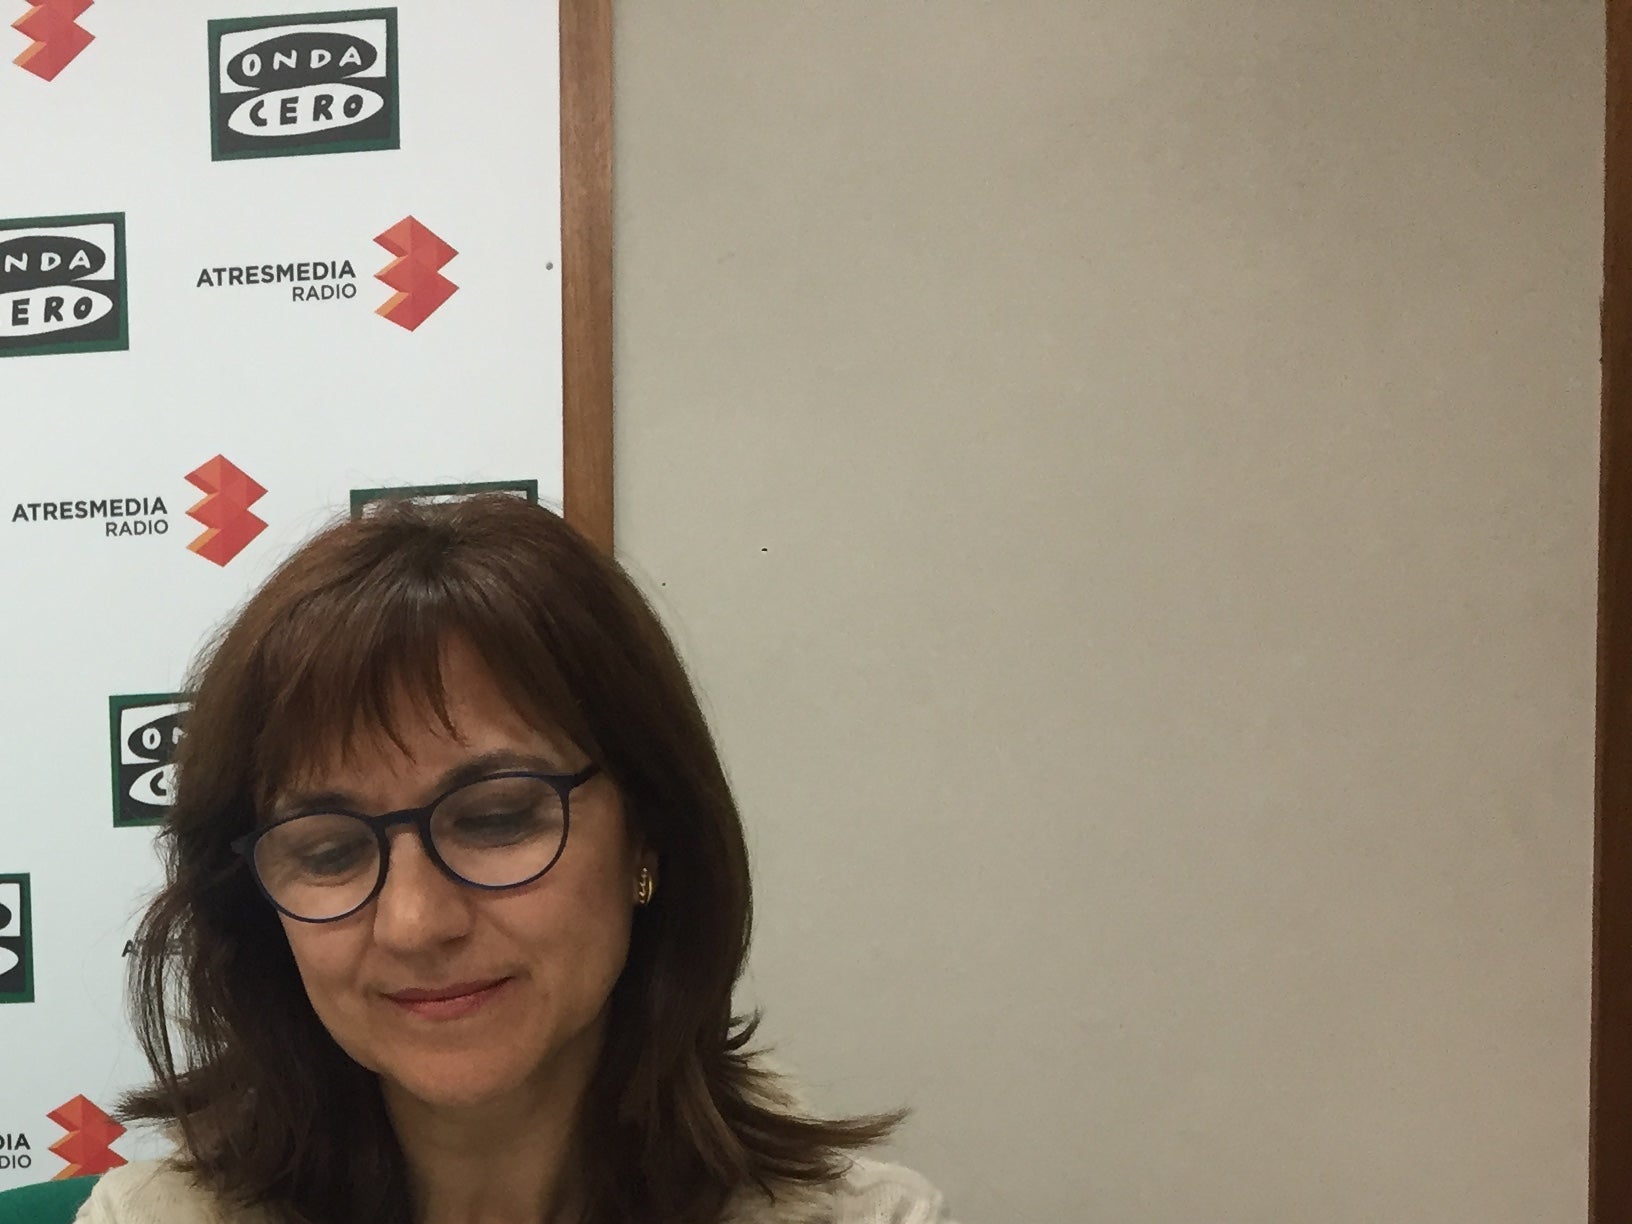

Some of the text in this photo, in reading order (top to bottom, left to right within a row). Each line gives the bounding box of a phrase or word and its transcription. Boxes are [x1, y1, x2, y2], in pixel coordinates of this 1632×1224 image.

[242, 46, 361, 76] ONDA
[250, 95, 363, 126] CERO
[197, 260, 356, 287] ATRESMEDIA
[293, 283, 357, 302] RADIO
[12, 496, 167, 522] ATRESMEDIA
[106, 519, 168, 537] RADIO
